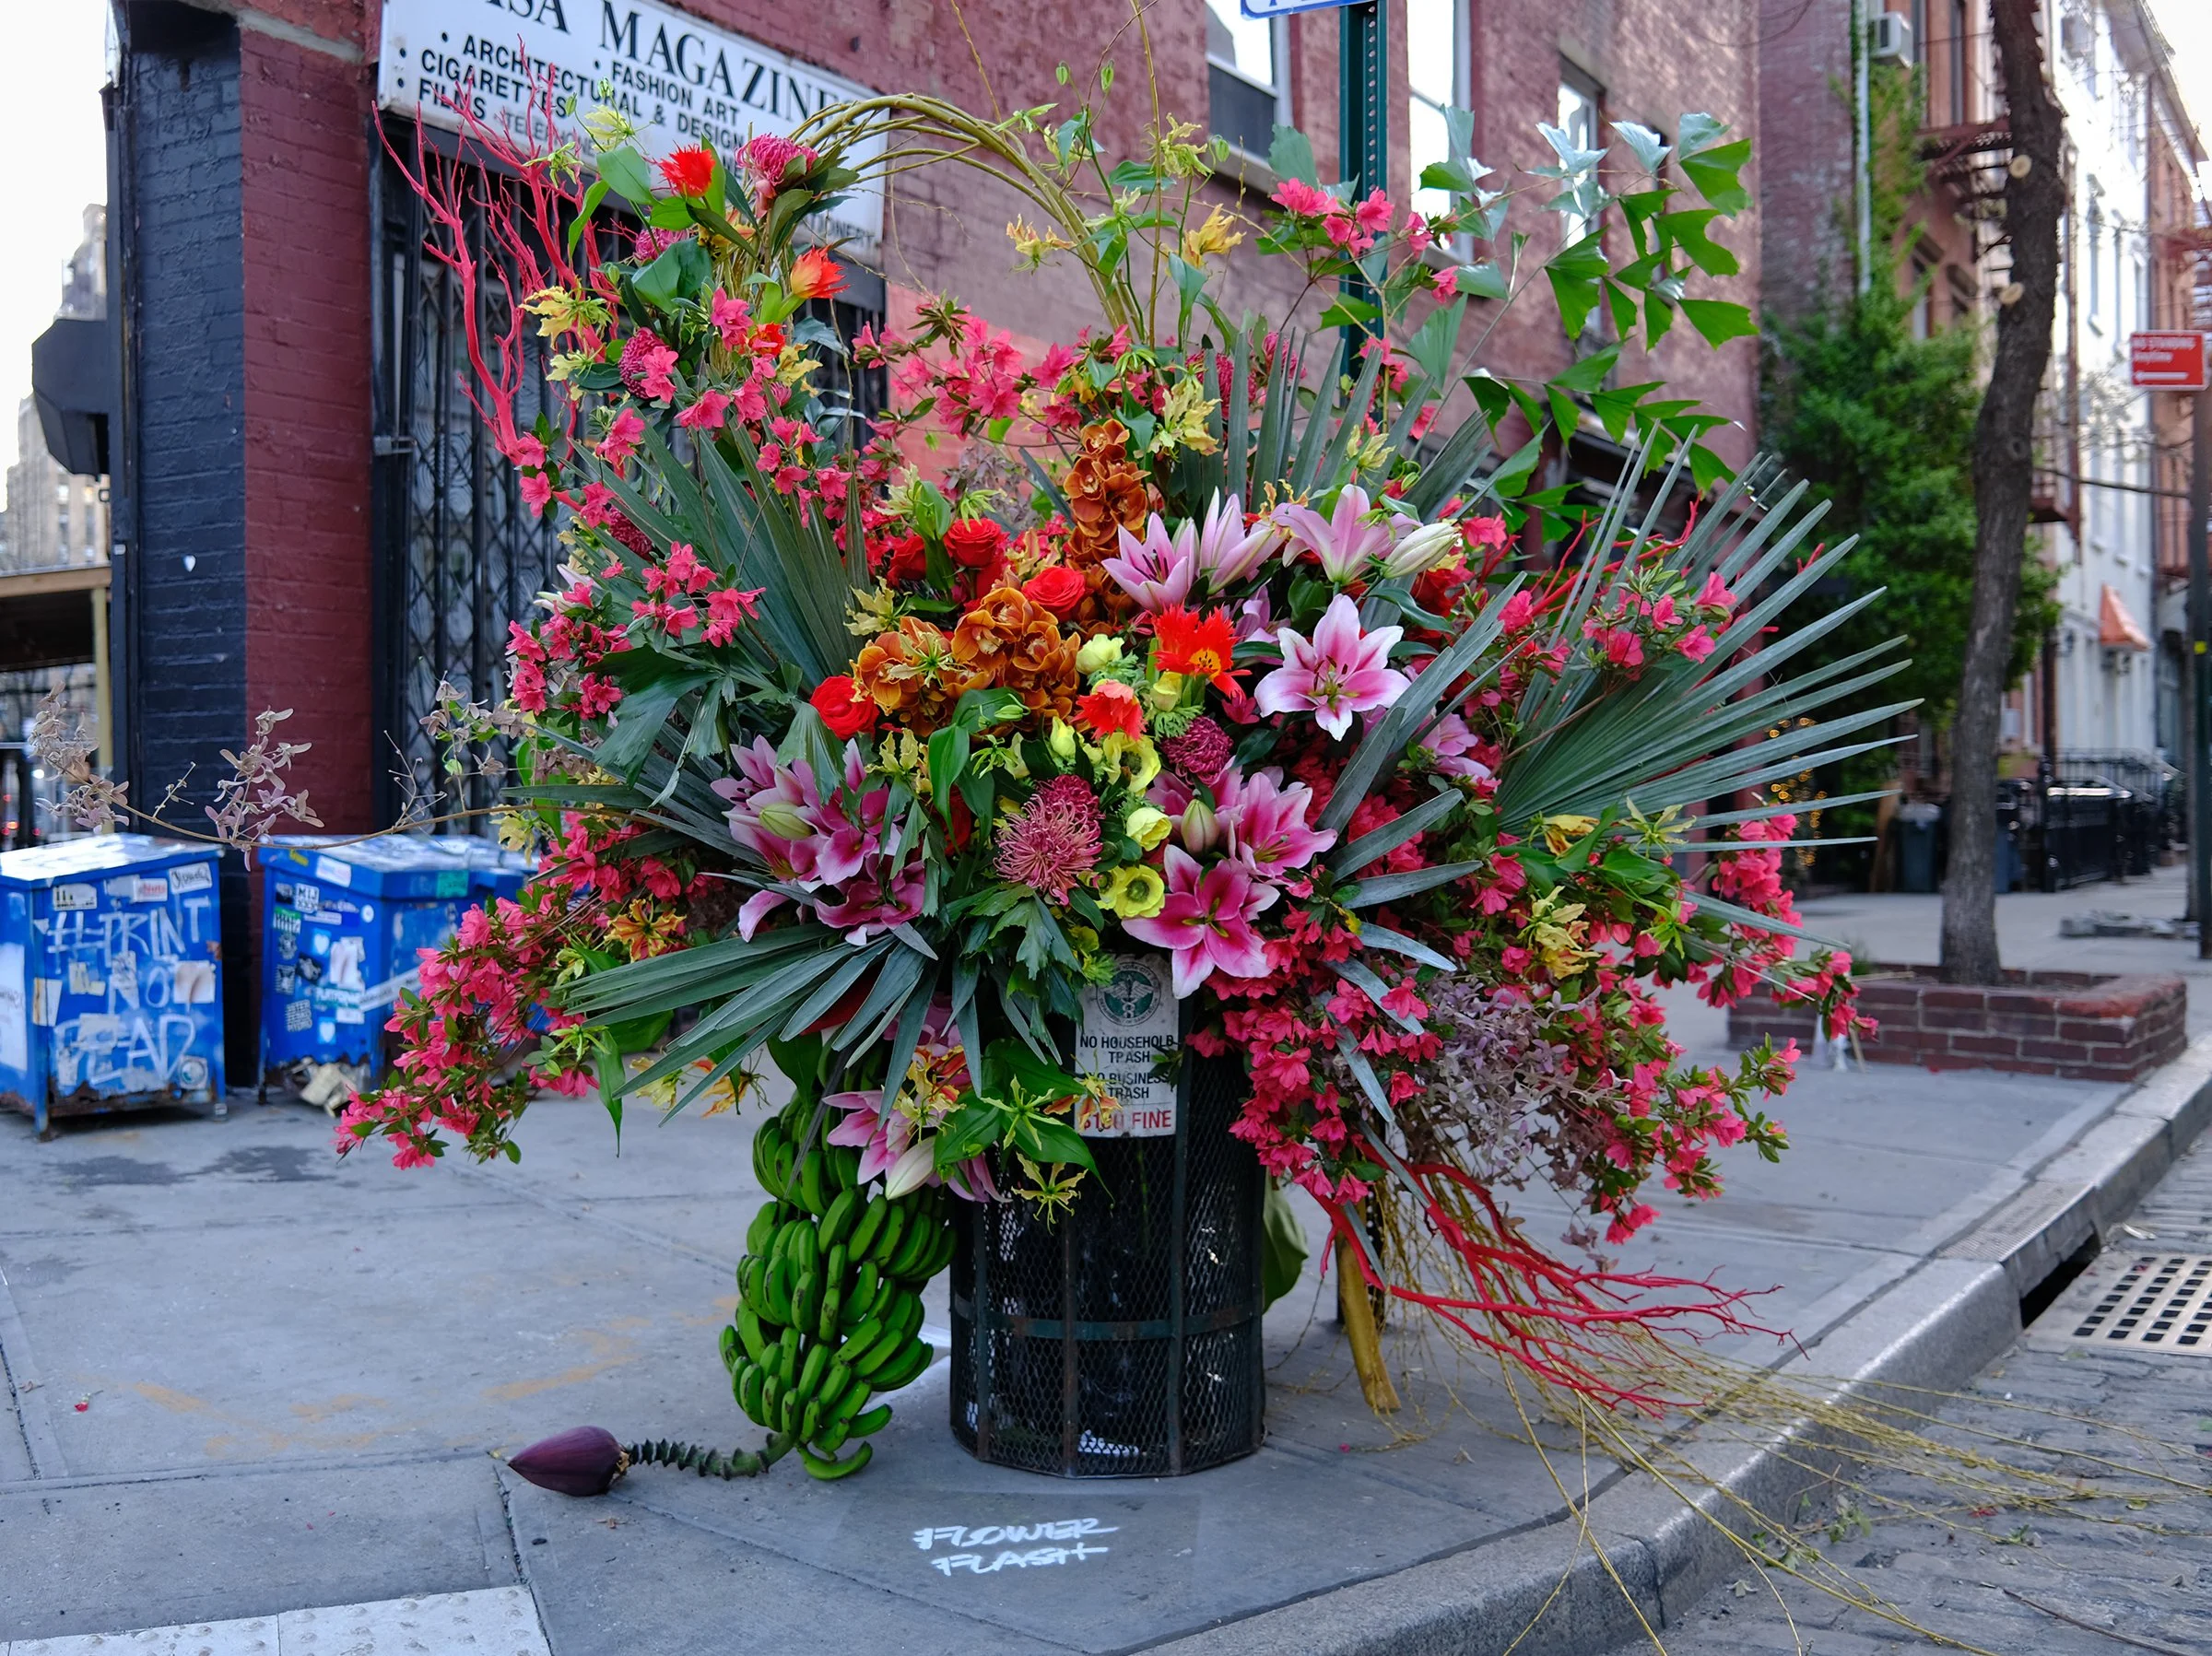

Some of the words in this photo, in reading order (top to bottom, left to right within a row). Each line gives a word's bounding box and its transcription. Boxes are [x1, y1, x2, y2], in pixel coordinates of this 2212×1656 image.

[463, 34, 643, 118] ARCHITECTURAL
[653, 103, 666, 126] &
[677, 111, 745, 151] DESIGN
[611, 60, 691, 110] FASHION
[702, 95, 741, 127] ART
[1079, 1035, 1098, 1049] NO
[1100, 1034, 1174, 1049] HOUSEHOLD
[1108, 1051, 1150, 1063] TRASH
[1108, 1086, 1150, 1099] TRASH
[1132, 1109, 1172, 1130] FINE
[912, 1517, 1120, 1551] FLOWER
[931, 1542, 1110, 1577] FLASH
